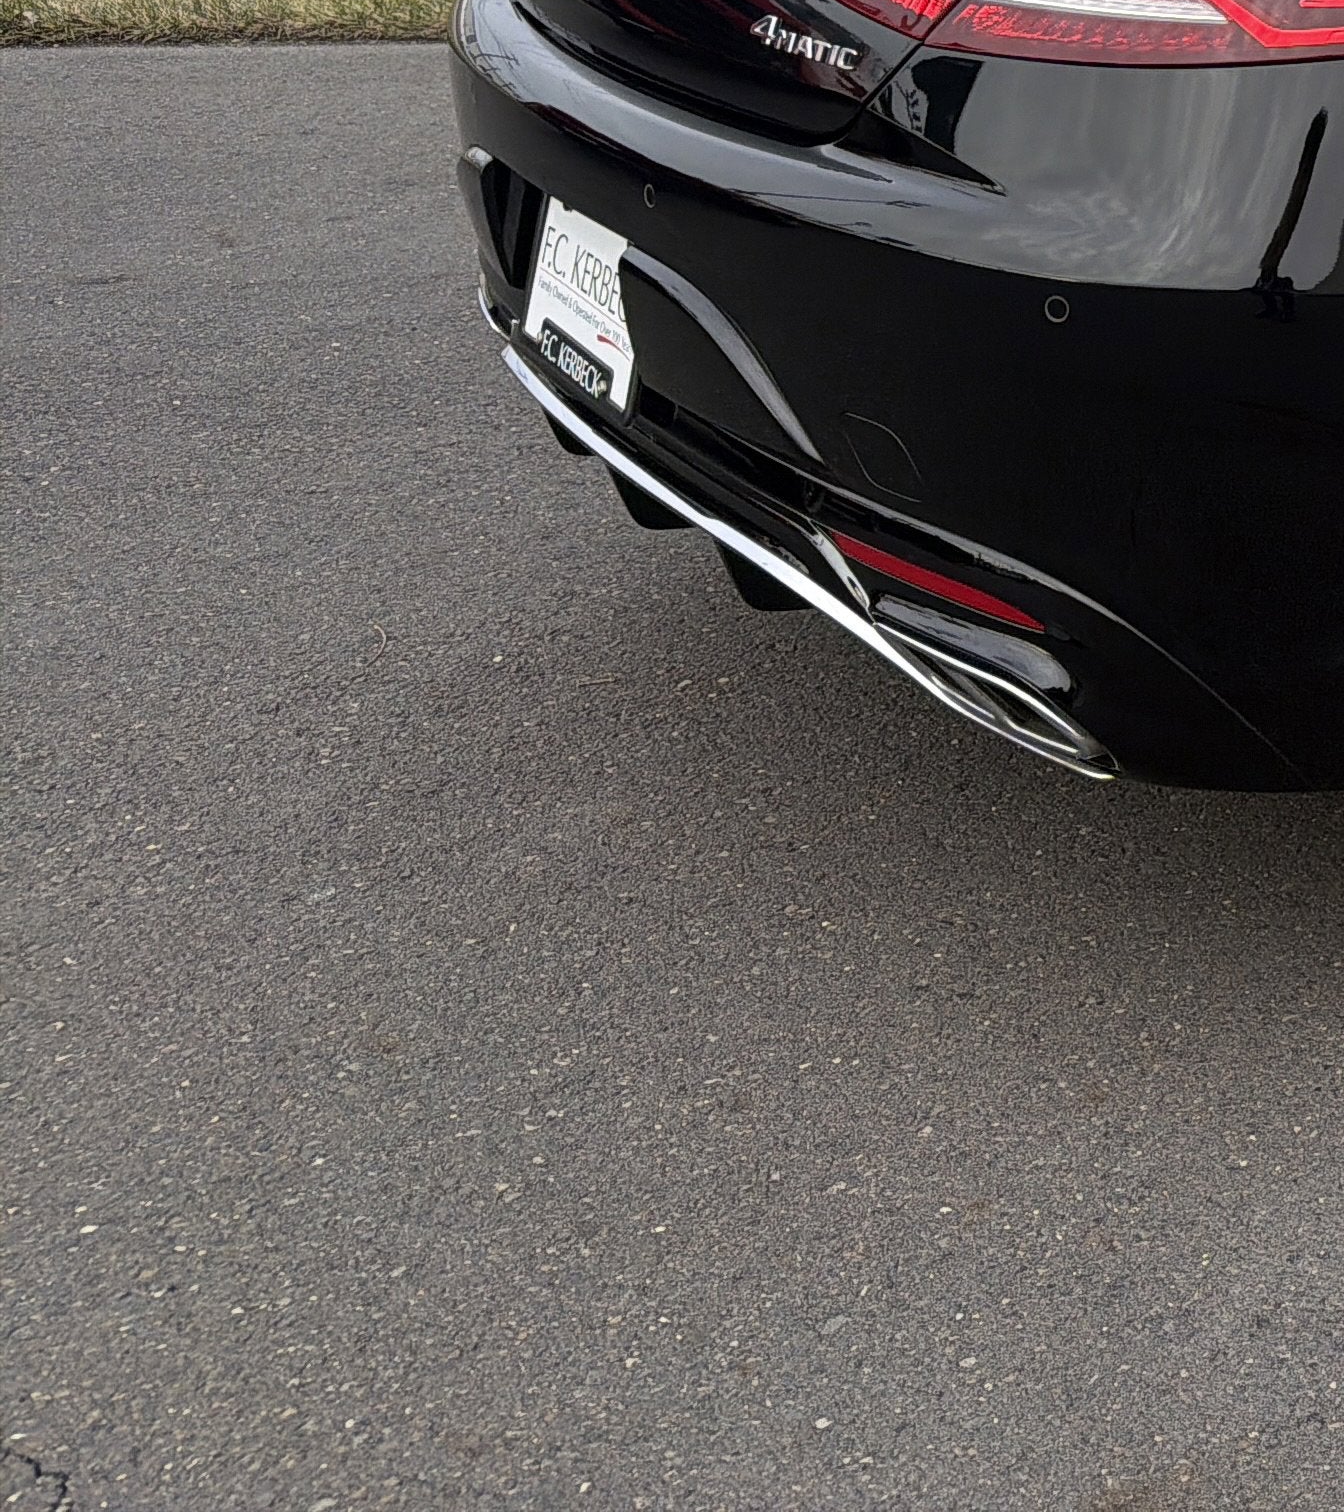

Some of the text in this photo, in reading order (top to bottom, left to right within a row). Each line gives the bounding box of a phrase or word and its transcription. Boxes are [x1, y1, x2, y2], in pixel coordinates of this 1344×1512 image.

[750, 14, 859, 70] 4MATIC
[541, 225, 569, 279] F.C.
[570, 244, 628, 323] KERBE
[557, 342, 602, 399] KERBECK
